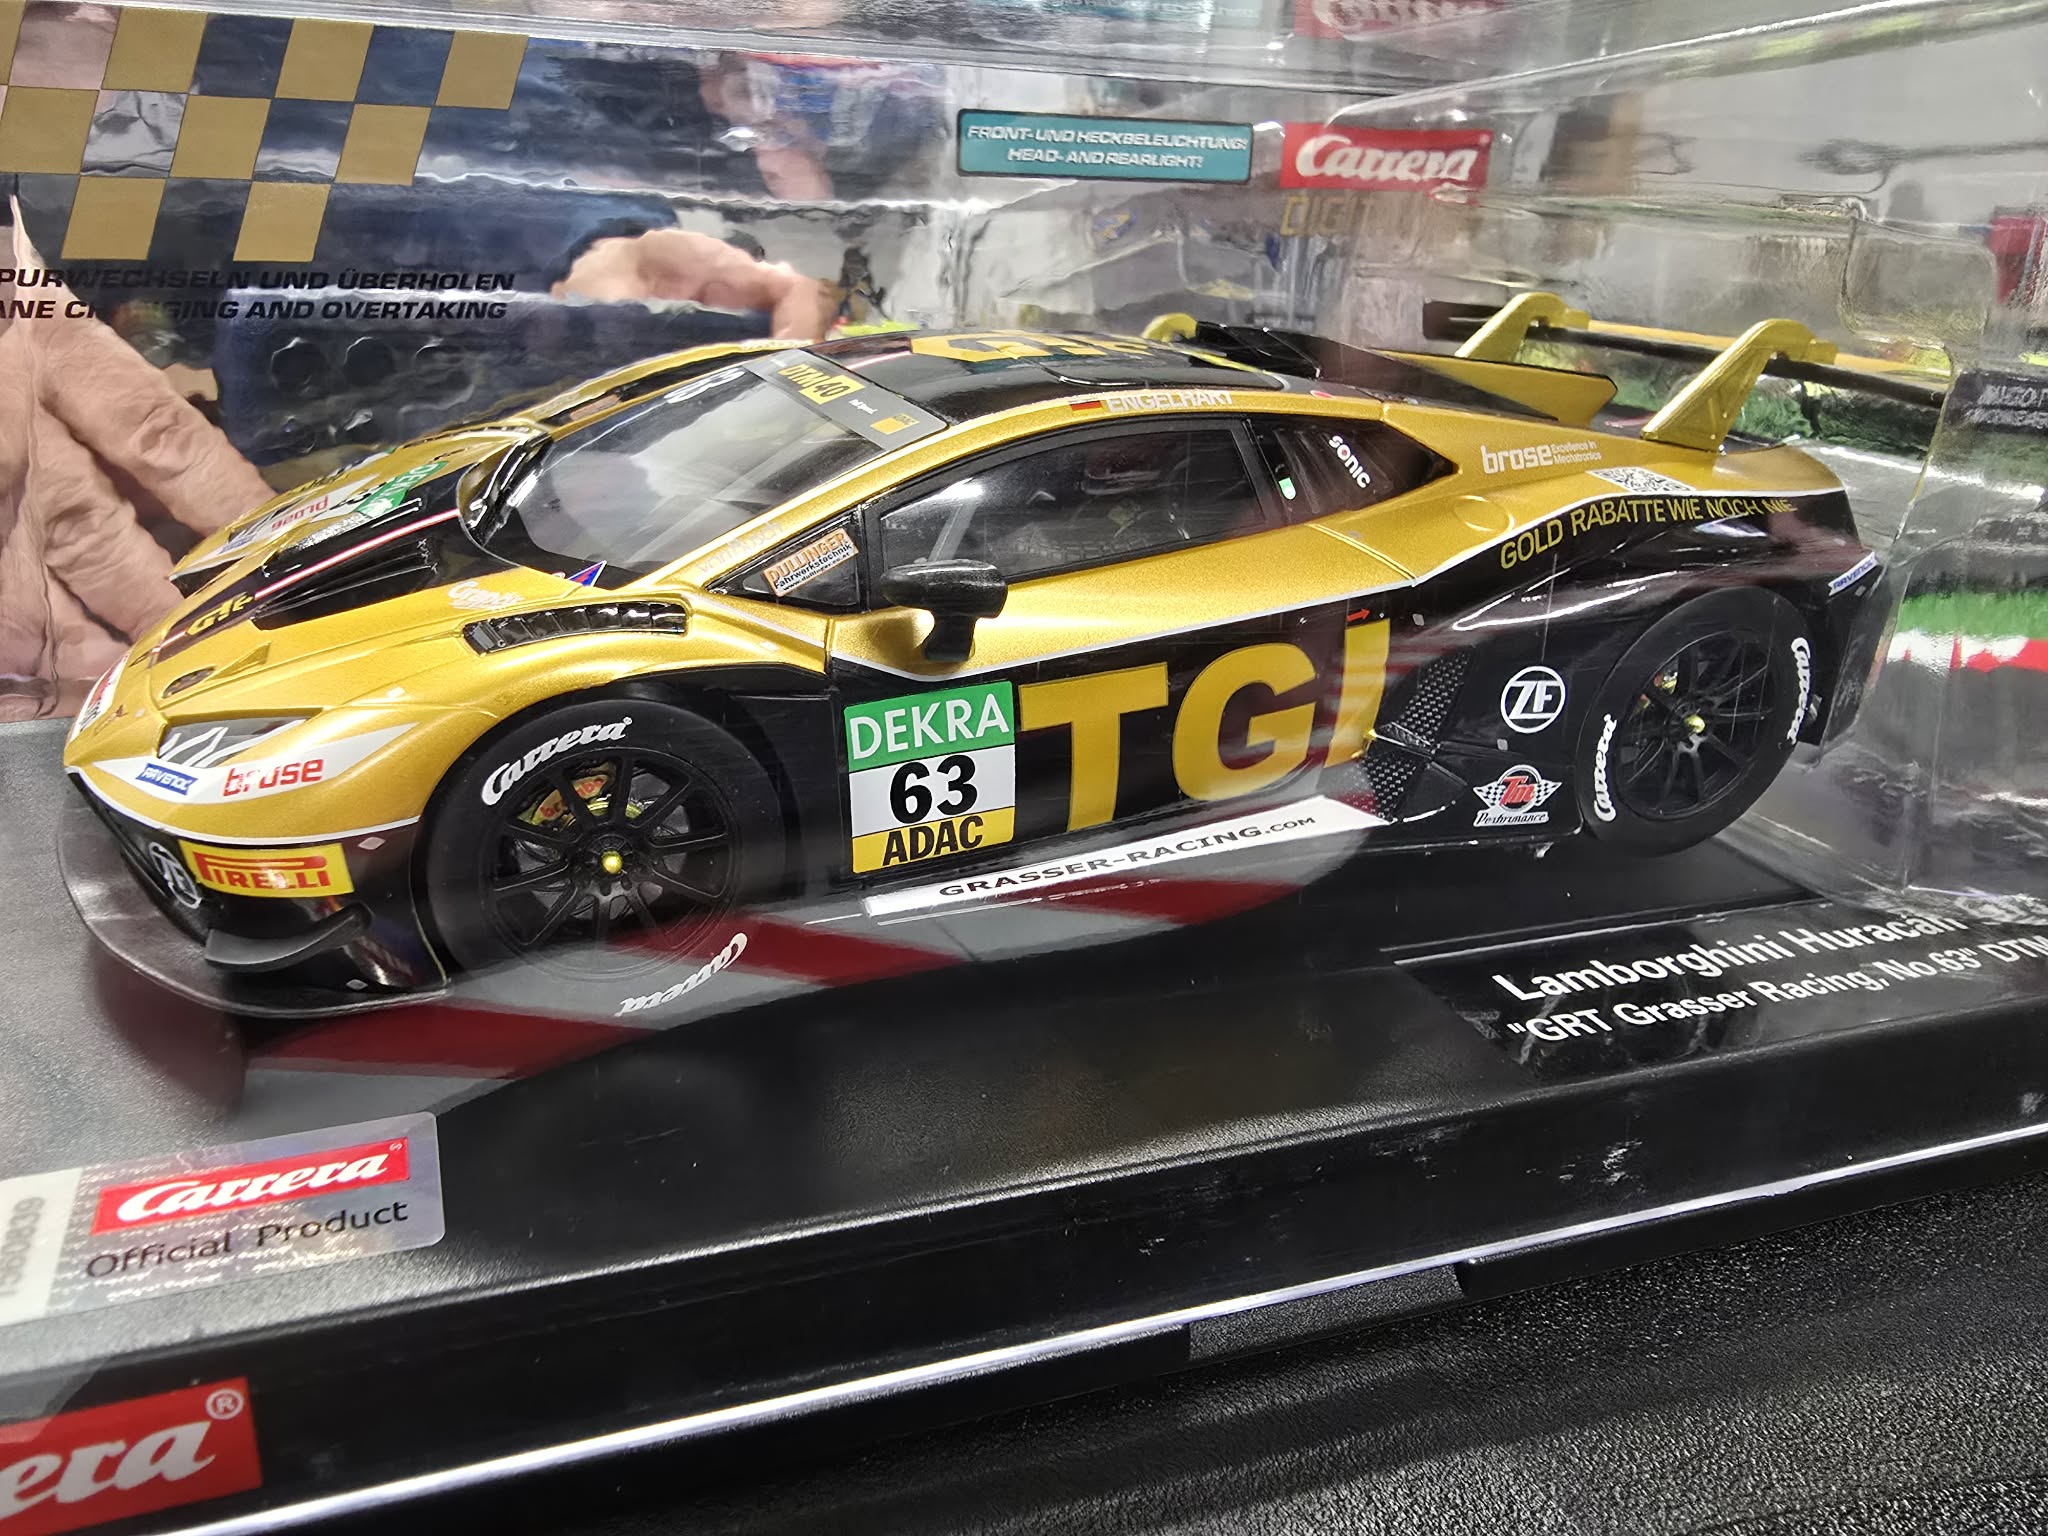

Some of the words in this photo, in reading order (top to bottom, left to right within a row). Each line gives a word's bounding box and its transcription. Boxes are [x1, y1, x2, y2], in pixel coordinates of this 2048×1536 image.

[966, 125, 1034, 140] FRONT-
[1036, 128, 1077, 143] UND
[1077, 131, 1248, 151] HECKBELEUCHTUNG!
[1008, 147, 1064, 162] HEAD-
[1067, 150, 1104, 165] AND
[1104, 153, 1204, 169] REARLIGHT!
[1295, 134, 1479, 183] Carrera
[259, 271, 330, 290] UND
[337, 267, 516, 291] ÜBERHOLEN
[245, 301, 315, 320] AND
[321, 301, 508, 320] OVERTAKING
[1106, 389, 1234, 413] ENGELHART
[1480, 444, 1554, 474] brose
[1500, 518, 1564, 570] GOLD
[1570, 498, 1666, 537] RABATTE
[1664, 498, 1703, 522] WIE
[1705, 498, 1762, 519] NOCH
[1508, 680, 1557, 720] ZF
[849, 693, 1010, 760] DEKRA
[481, 720, 628, 806] Carrera
[889, 754, 978, 824] 63
[881, 815, 984, 867] ADAC
[192, 851, 331, 890] PIRELLI
[1492, 933, 1797, 1002] Lamborghini
[1507, 1006, 1614, 1043] "GRT
[1611, 985, 1757, 1029] Grasser
[1746, 969, 1890, 1004] Racing,
[1872, 947, 1982, 982] No.63"
[117, 1152, 390, 1222] Carrera
[86, 1232, 232, 1278] Official
[257, 1200, 409, 1248] Product
